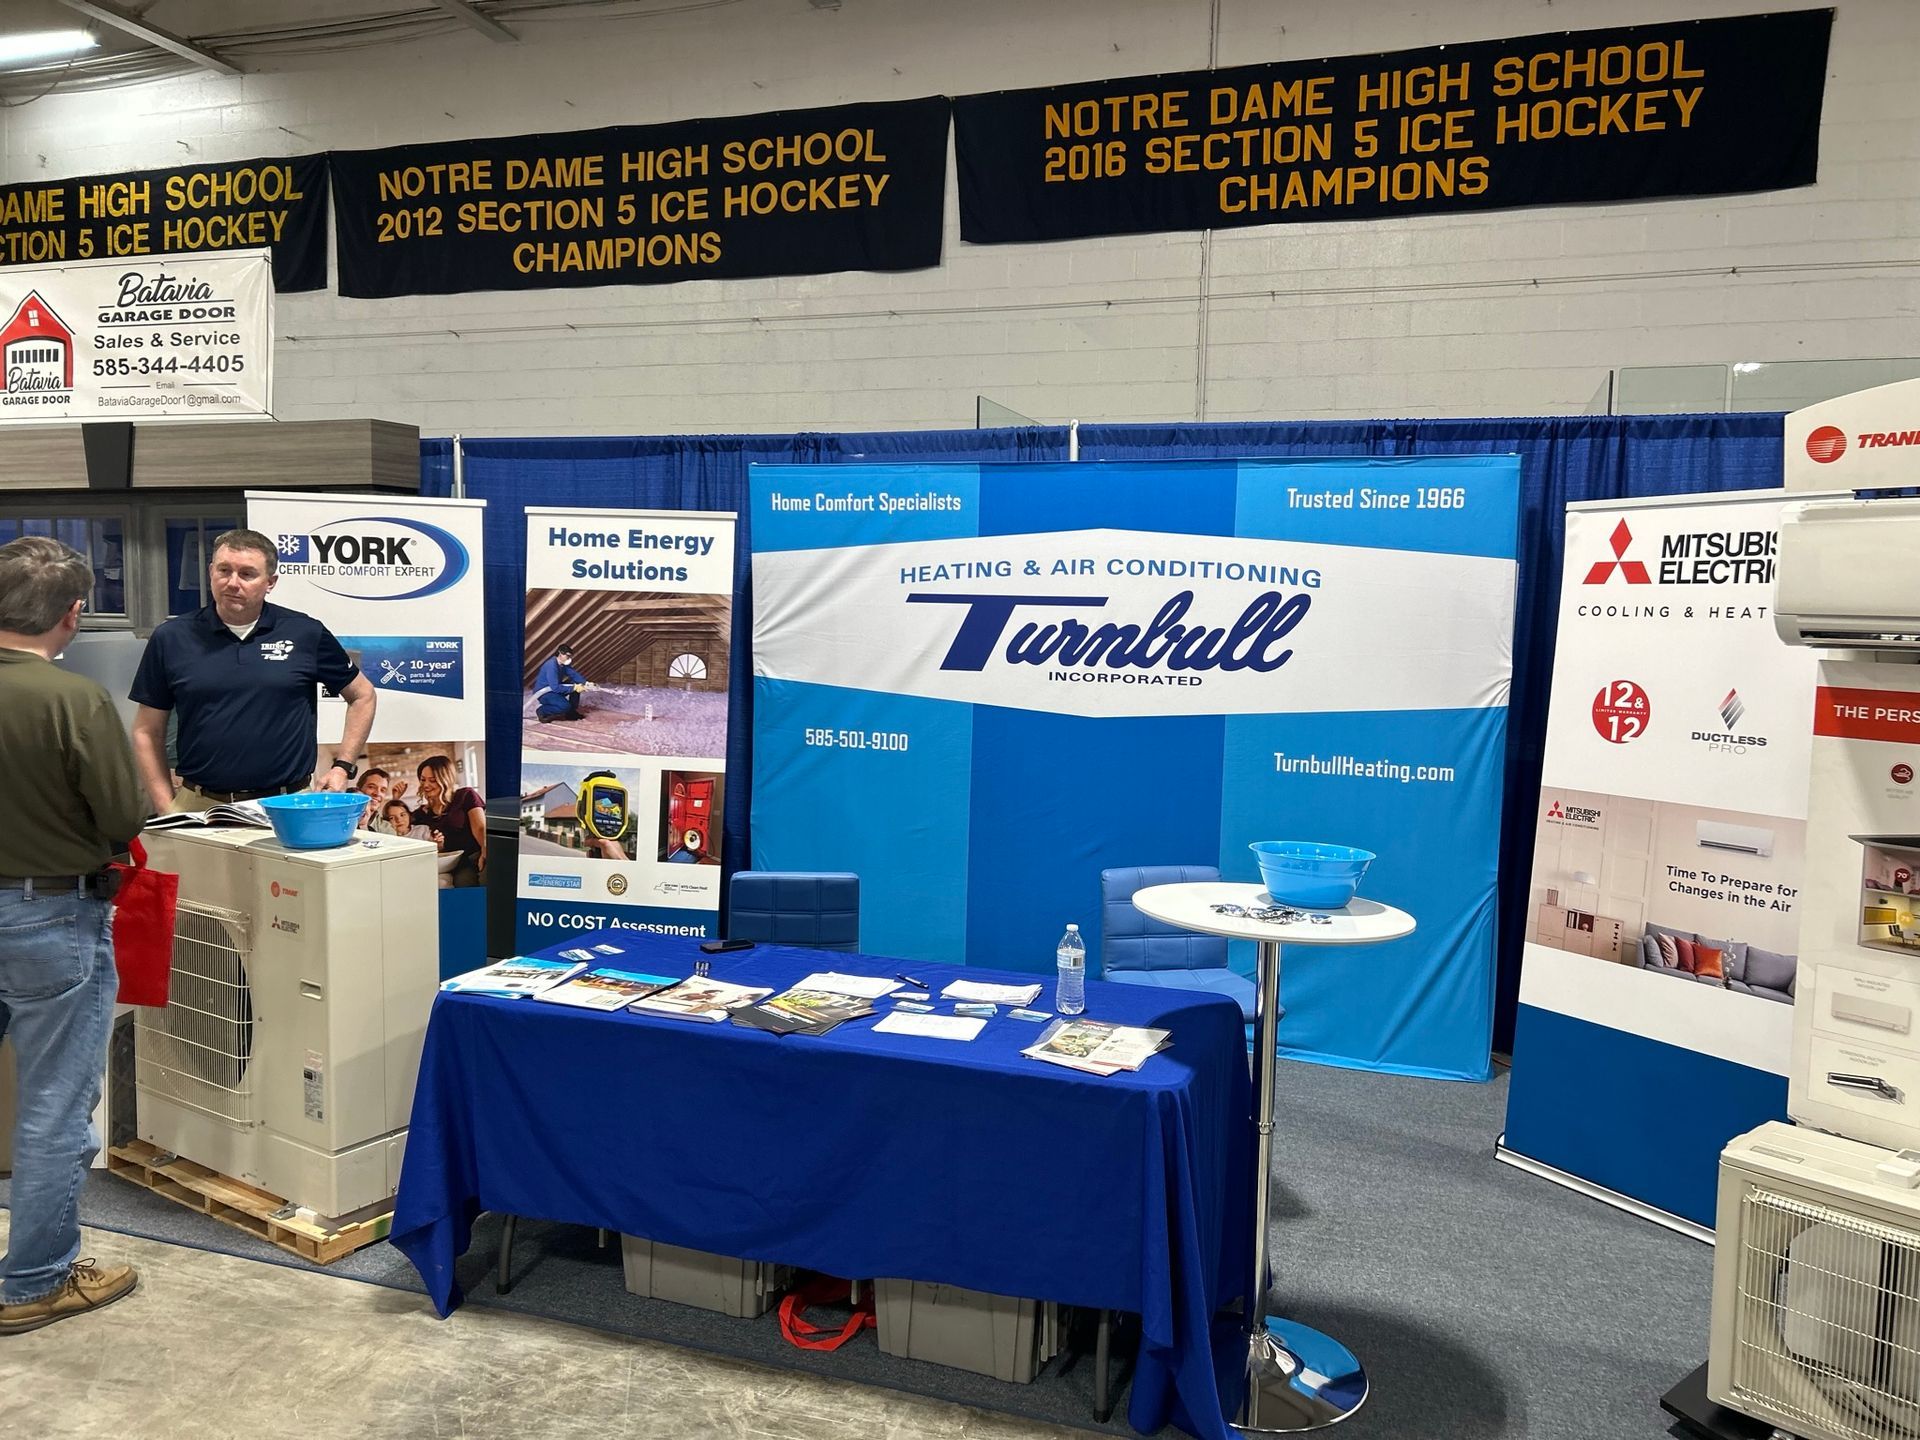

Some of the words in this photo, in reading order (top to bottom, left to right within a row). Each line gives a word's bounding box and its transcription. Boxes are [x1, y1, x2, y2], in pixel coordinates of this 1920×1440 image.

[1045, 90, 1188, 140] NOTRE
[1211, 77, 1334, 126] DAME
[1358, 62, 1469, 112] HIGH
[1493, 40, 1704, 96] SCHOOL
[1045, 142, 1125, 182] 2016
[1145, 122, 1332, 174] SECTION
[1354, 119, 1377, 157] 5
[1399, 110, 1475, 153] ICE
[1497, 87, 1704, 144] HOCKEY
[379, 160, 492, 201] NOTRE
[506, 155, 604, 191] DAME
[622, 144, 708, 183] HIGH
[723, 129, 886, 174] SCHOOL
[0, 189, 64, 225] AME
[80, 180, 150, 219] HIGH
[165, 166, 303, 211] SCHOOL
[1219, 157, 1489, 213] CHAMPIONS
[377, 207, 442, 243] 2012
[458, 197, 603, 232] SECTION
[617, 194, 635, 225] 5
[651, 188, 709, 224] ICE
[725, 174, 889, 218] HOCKEY
[79, 229, 94, 257] 5
[107, 222, 150, 254] ICE
[163, 210, 289, 250] HOCKEY
[513, 232, 722, 273] CHAMPIONS
[117, 272, 213, 308] Batavia
[98, 309, 172, 323] GARAGE
[179, 307, 235, 319] DOOR
[94, 334, 143, 349] Sales
[151, 333, 163, 347] &
[170, 331, 240, 346] Service
[93, 355, 244, 376] 585-344-4405
[8, 366, 62, 394] Batavia
[156, 381, 175, 390] Email
[2, 396, 39, 405] GARAGE
[42, 395, 70, 404] DOOR
[98, 394, 241, 407] BataviaGarageDoor1@gmail.com
[771, 494, 812, 512] Home
[815, 493, 876, 513] Comfort
[879, 493, 962, 515] Specialists
[1287, 488, 1354, 509] Trusted
[1360, 488, 1410, 509] Since
[1415, 488, 1466, 509] 1966
[549, 527, 620, 548] Home
[628, 530, 714, 555] Energy
[279, 564, 335, 576] CERTIFIED
[339, 565, 390, 577] COMFORT
[395, 567, 435, 577] EXPERT
[572, 559, 688, 582] Solutions
[900, 559, 1013, 585] HEATING
[1023, 560, 1043, 577] &
[1051, 558, 1096, 576] AIR
[1106, 558, 1322, 589] CONDITIONING
[1659, 559, 1776, 584] ELECTRI
[1578, 605, 1670, 618] COOLING
[1684, 606, 1694, 618] &
[1709, 607, 1767, 619] HEAT
[906, 590, 1312, 673] Turnbull
[434, 641, 459, 649] YORK
[1049, 671, 1203, 687] INCORPORATED
[1833, 704, 1869, 719] THE
[805, 728, 909, 752] 585-501-9100
[1608, 716, 1640, 741] 12
[1691, 732, 1767, 746] DUCTLESS
[1709, 743, 1746, 754] PRO
[1274, 752, 1455, 783] TurnbullHeating.com
[1565, 813, 1595, 823] ELECTRIC
[1566, 806, 1601, 817] MITSUBISHI
[544, 879, 566, 888] ENERGY
[567, 880, 580, 889] STAR
[1666, 865, 1697, 880] Time
[1701, 871, 1716, 883] To
[1720, 875, 1773, 895] Prepare
[1777, 883, 1798, 898] for
[1669, 881, 1723, 902] Changes
[1728, 890, 1740, 902] in
[1744, 893, 1766, 908] the
[1770, 899, 1792, 913] Air
[527, 911, 553, 927] NO
[558, 913, 606, 930] COST
[610, 917, 706, 938] Assessment
